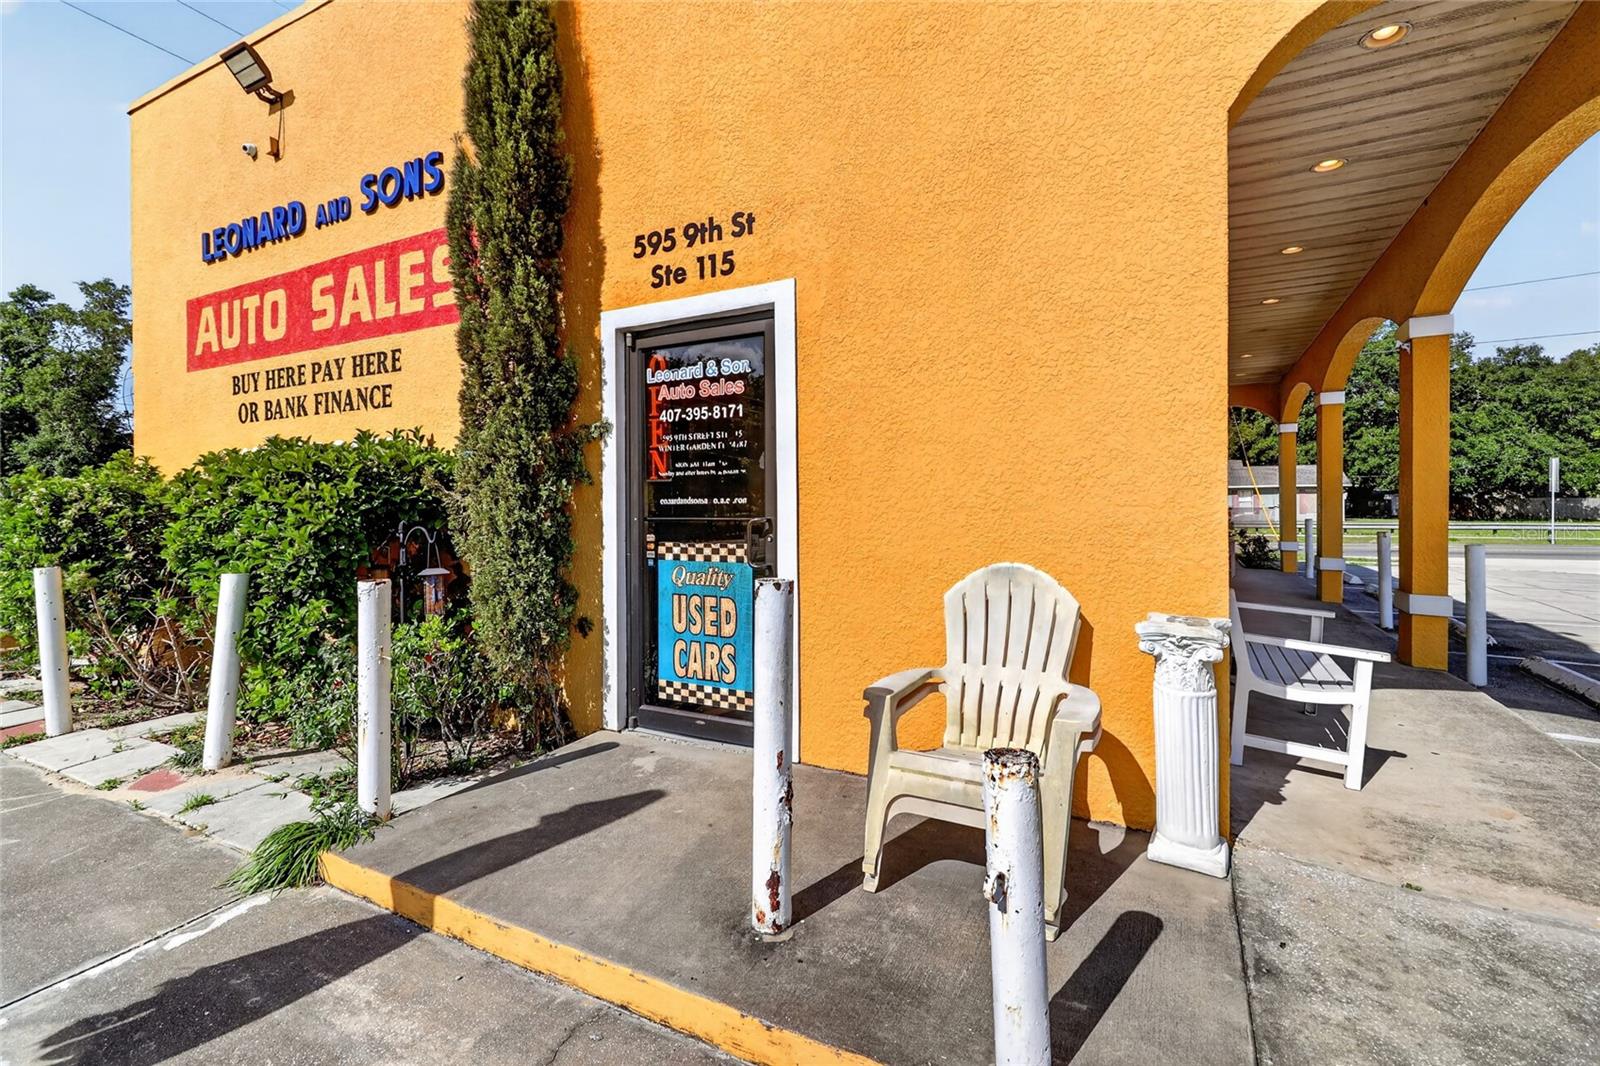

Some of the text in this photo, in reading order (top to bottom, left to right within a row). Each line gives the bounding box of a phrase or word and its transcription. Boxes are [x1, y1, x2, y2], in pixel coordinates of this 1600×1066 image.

[202, 151, 444, 262] LEONARD AND SONS
[633, 212, 755, 259] 595 9th St
[651, 250, 735, 289] Ste 115
[195, 244, 456, 356] AUTO SALES
[232, 348, 402, 395] BUY HERE PAY HERE
[646, 362, 703, 384] Leonard
[706, 360, 718, 377] &
[658, 378, 745, 401] Auto Sales
[239, 384, 393, 424] OR BANK FINANCE
[659, 404, 743, 422] 407-395-8171
[671, 565, 735, 591] Quality
[672, 593, 737, 638] USED
[673, 639, 737, 685] CARS
